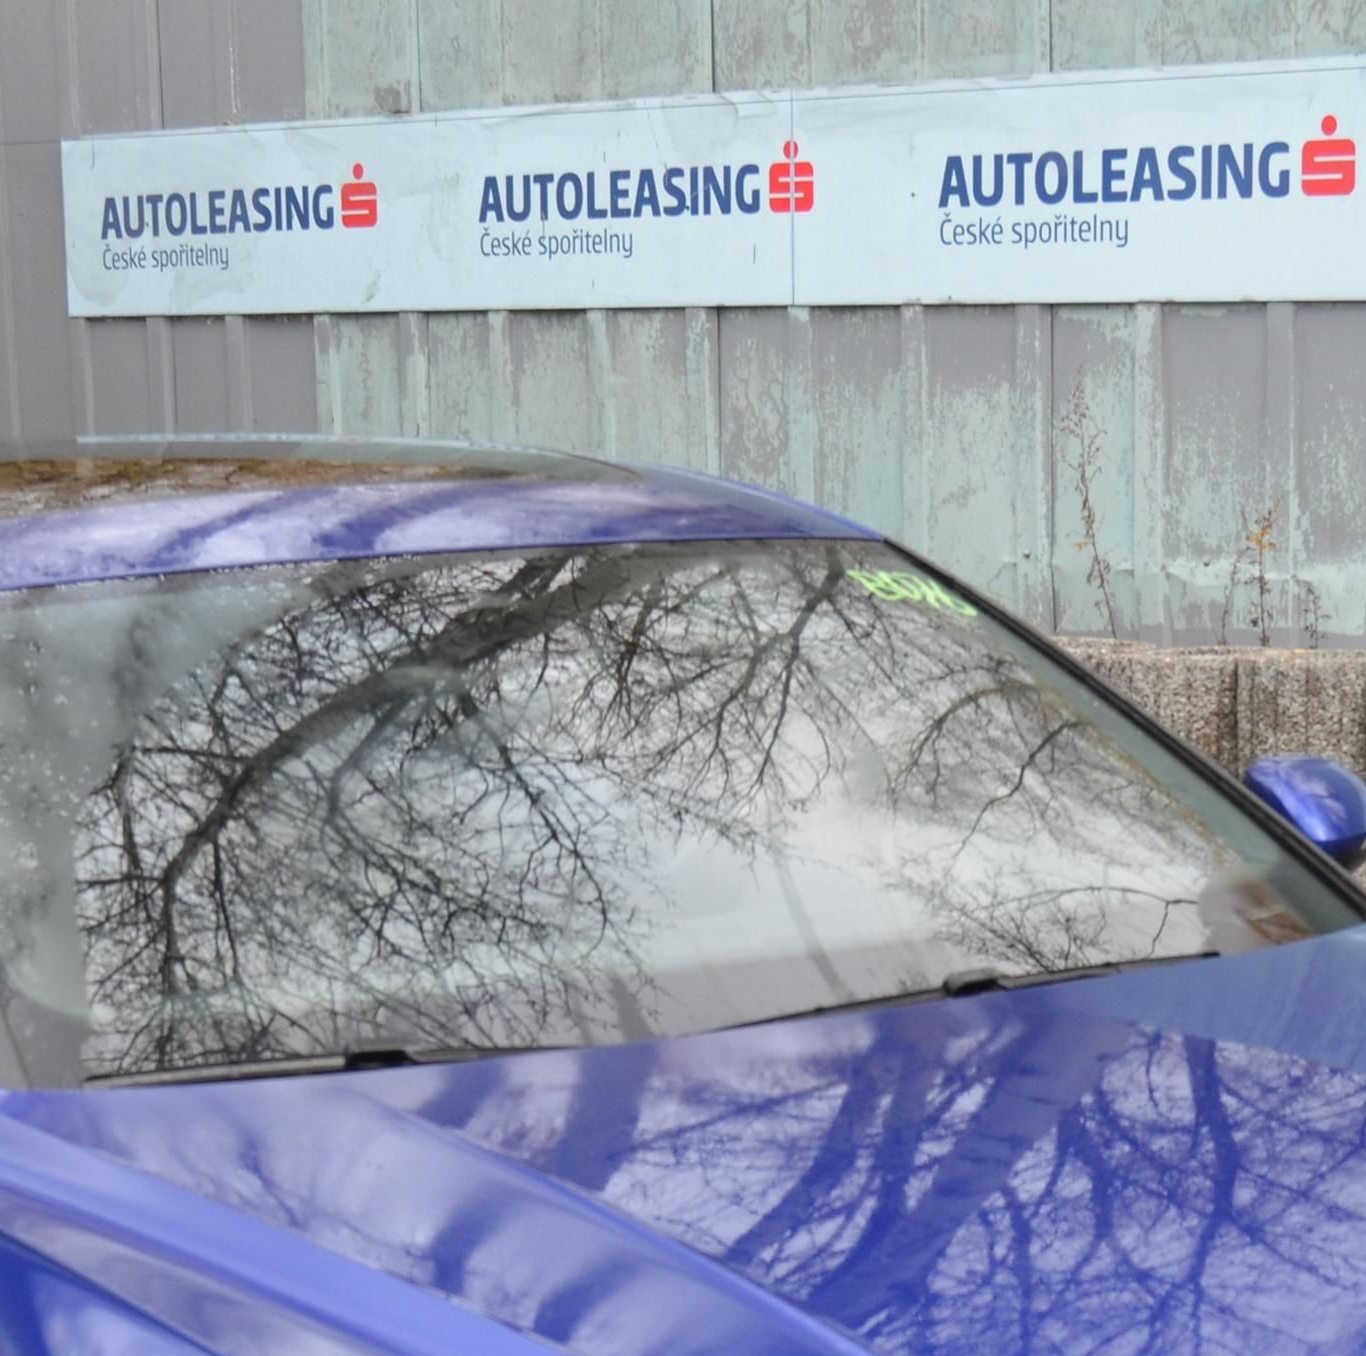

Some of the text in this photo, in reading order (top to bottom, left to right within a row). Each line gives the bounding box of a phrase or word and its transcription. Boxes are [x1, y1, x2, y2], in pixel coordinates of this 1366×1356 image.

[479, 164, 760, 223] AUTOLEASING
[939, 142, 1290, 208] AUTOLEASING
[101, 185, 334, 239] AUTOLEASING
[939, 210, 1128, 249] České spořitelny
[102, 241, 229, 272] České spořitelny
[480, 225, 633, 260] České spořitelny
